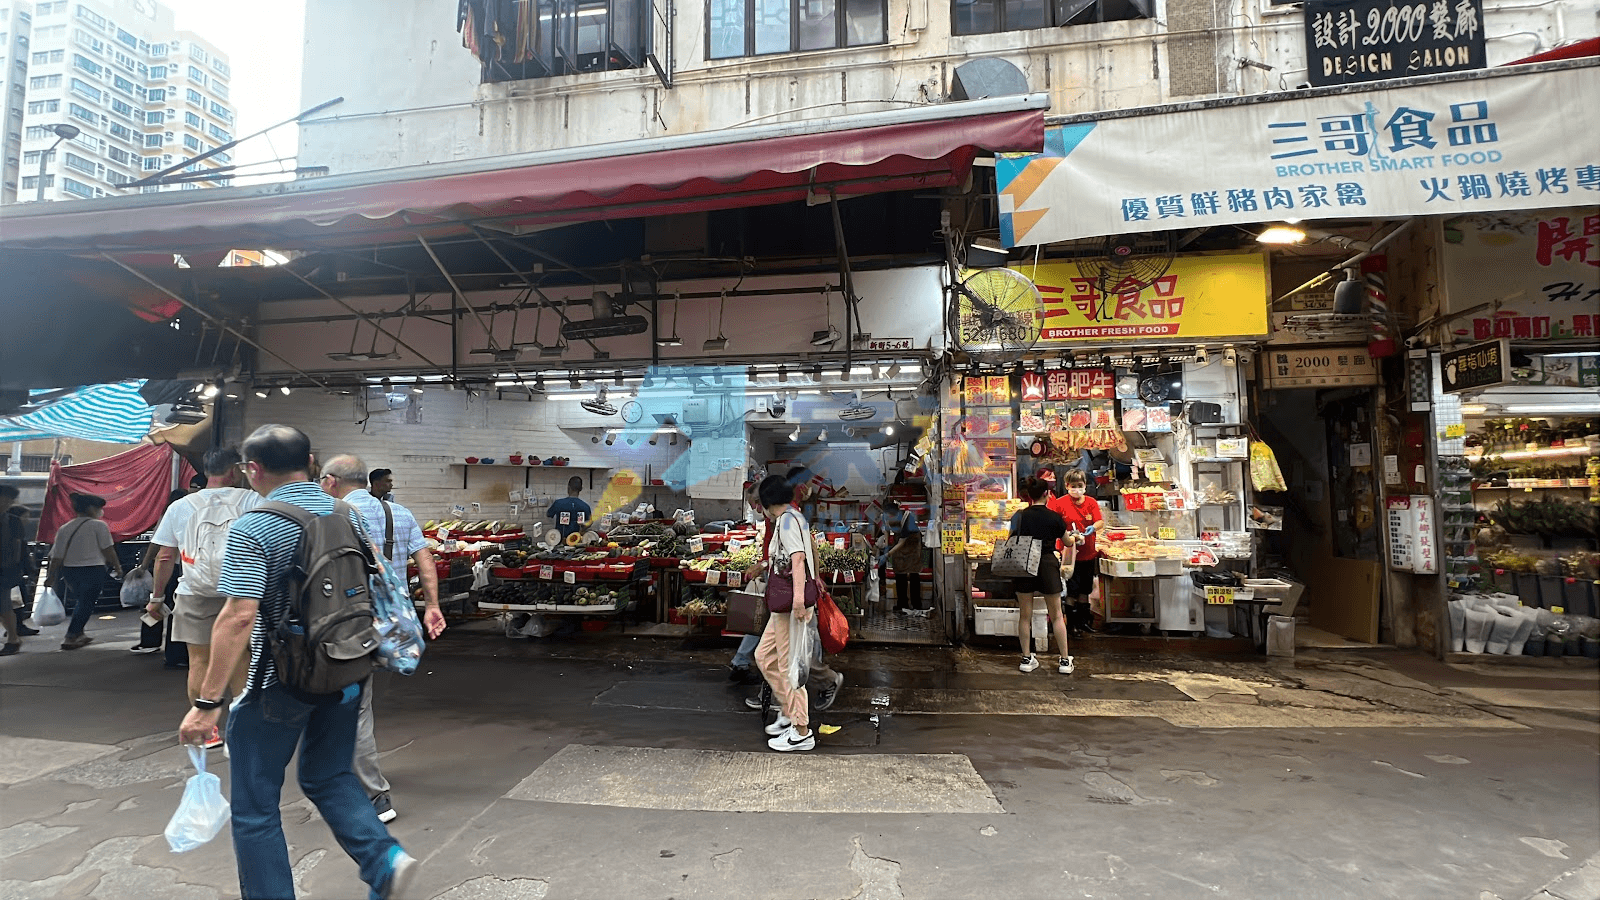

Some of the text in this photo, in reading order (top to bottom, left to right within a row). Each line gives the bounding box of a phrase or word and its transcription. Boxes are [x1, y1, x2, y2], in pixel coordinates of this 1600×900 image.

[1322, 46, 1470, 81] DESIGN SALON
[1267, 100, 1499, 160] 三哥食品
[1276, 149, 1503, 178] BROTHER SMART FOOD
[1120, 182, 1367, 222] 優質鮮豬肉家禽
[1034, 274, 1185, 322] 三哥食品
[1048, 324, 1170, 339] BROTHER FRESH FOOD
[1295, 356, 1330, 368] 2000
[1022, 372, 1114, 399] 火鍋肥牛
